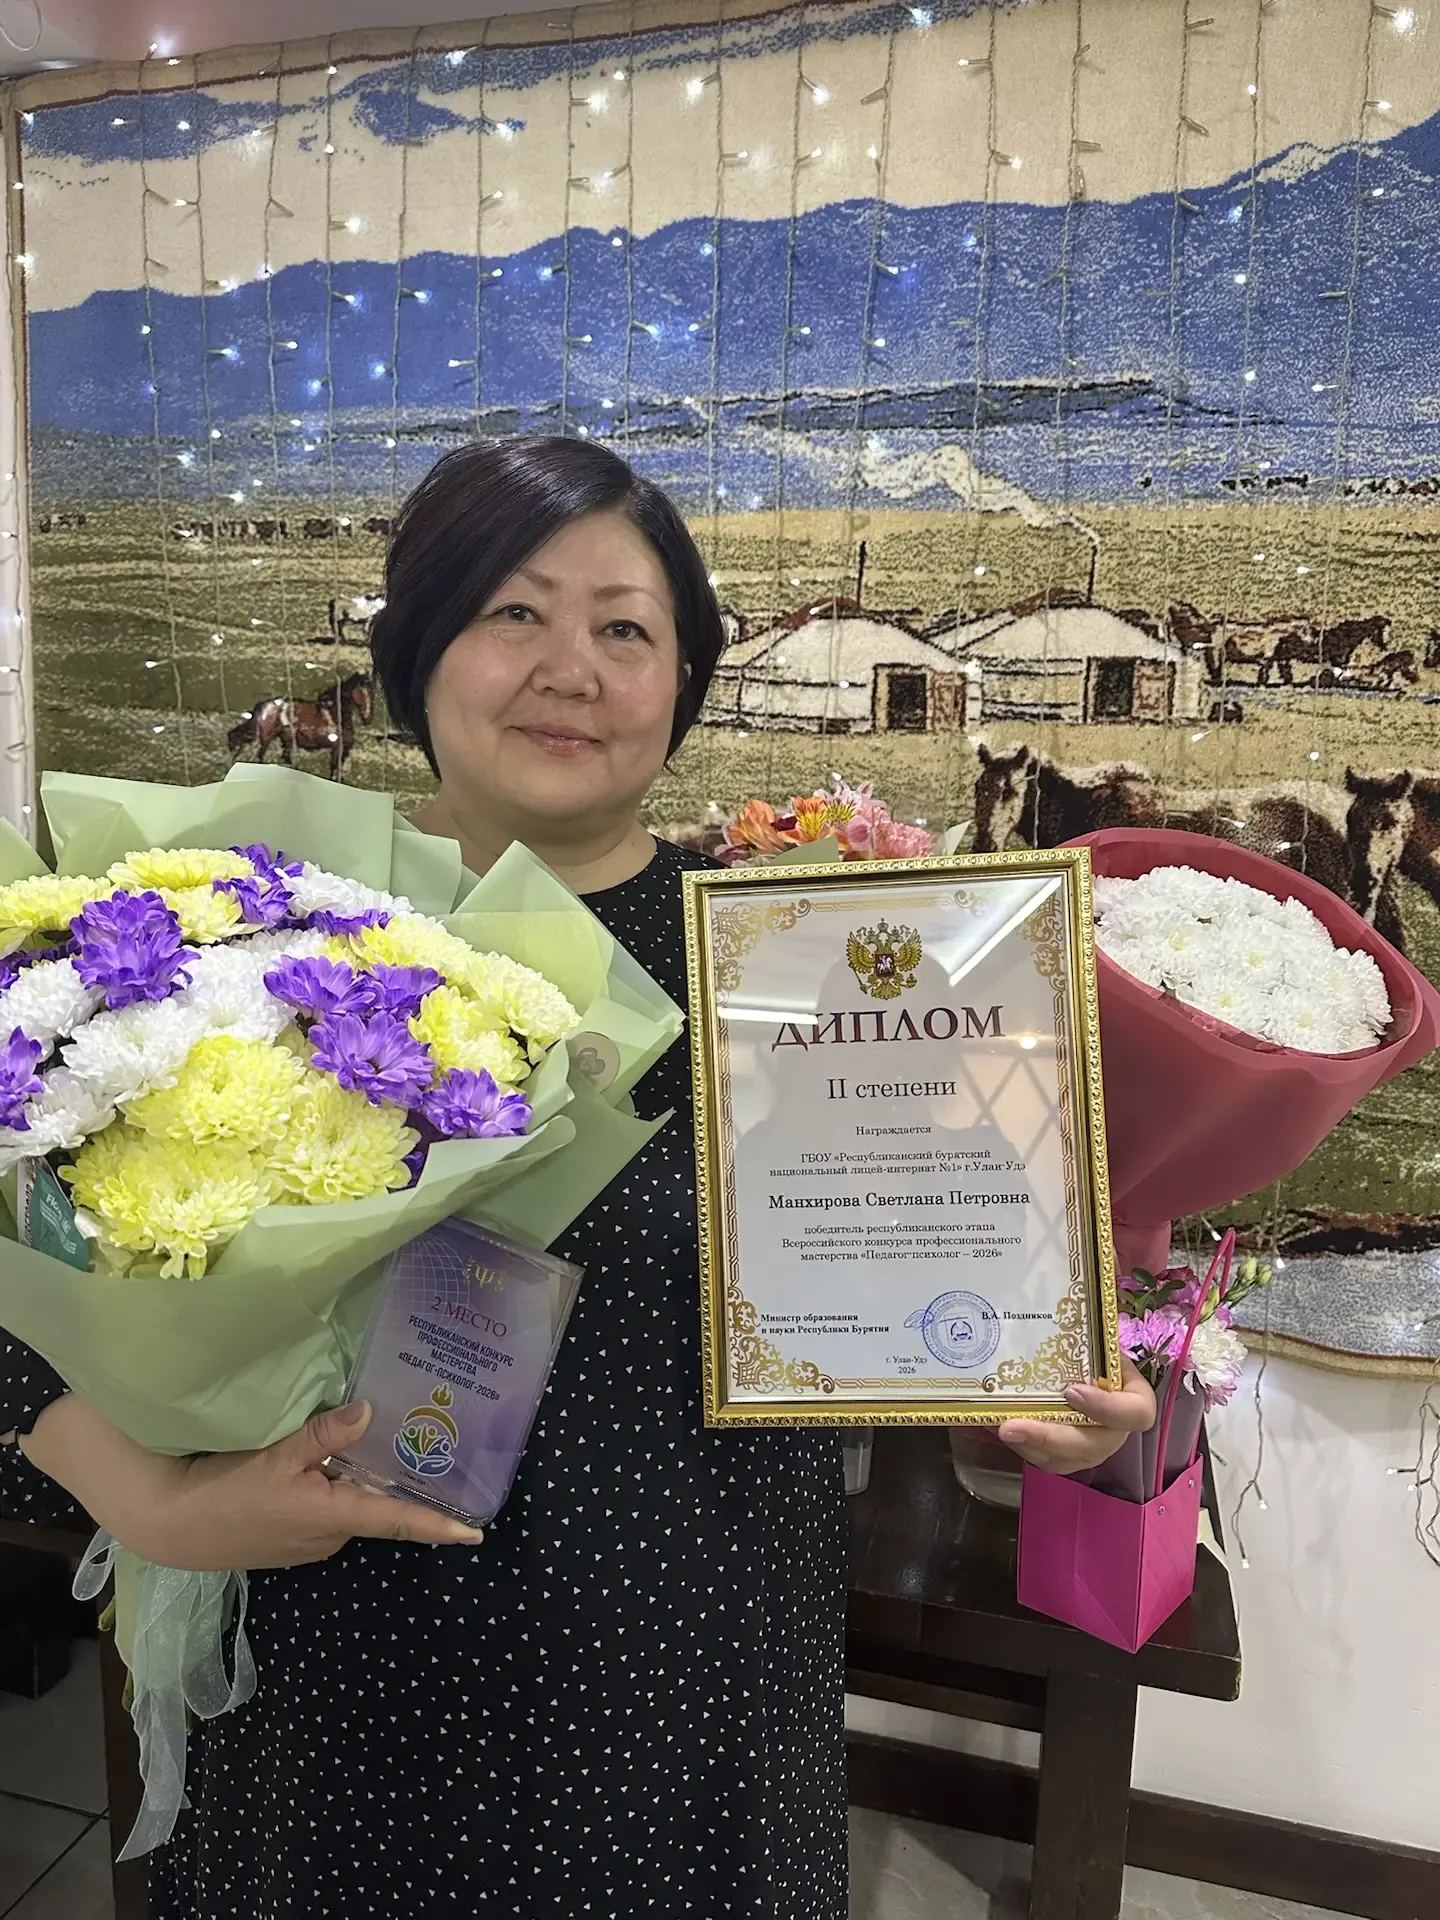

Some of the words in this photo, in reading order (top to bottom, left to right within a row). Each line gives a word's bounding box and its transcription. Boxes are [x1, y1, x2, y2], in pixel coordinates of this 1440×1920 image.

[772, 1005, 1006, 1052] ДИПЛОМ
[856, 1080, 957, 1099] степени
[855, 1125, 932, 1137] Награждается
[801, 1152, 832, 1164] ГБОУ
[834, 1150, 932, 1164] «Республиканский
[935, 1149, 991, 1163] бурятский
[769, 1164, 848, 1178] национальный
[850, 1162, 936, 1175] лицей-интернат
[768, 1195, 861, 1211] Манхирова
[865, 1191, 944, 1207] Светлана
[948, 1190, 1030, 1206] Петровна
[804, 1223, 864, 1236] победитель
[866, 1222, 963, 1236] республиканского
[965, 1223, 996, 1233] этапа
[782, 1237, 862, 1250] Всероссийского
[864, 1238, 913, 1249] конкурса
[916, 1236, 1021, 1248] профессионального
[800, 1252, 858, 1261] мастерства
[972, 1248, 1003, 1259] 2026»
[431, 1296, 442, 1312] 2
[444, 1301, 507, 1338] МЕСТО
[760, 1313, 802, 1325] Министр
[803, 1312, 859, 1323] образования
[1003, 1311, 1053, 1321] Поздников
[769, 1326, 796, 1336] науки
[797, 1324, 850, 1336] Республики
[851, 1323, 890, 1335] Бурятия
[409, 1315, 481, 1353] РЕСПУБЛИКАНСКИЙ
[480, 1342, 515, 1367] КОНКУРС
[417, 1331, 498, 1372] ПРОФЕССИОНАЛЬНОГО
[430, 1349, 477, 1376] МАСТЕРСТВА
[898, 1366, 916, 1375] 2026
